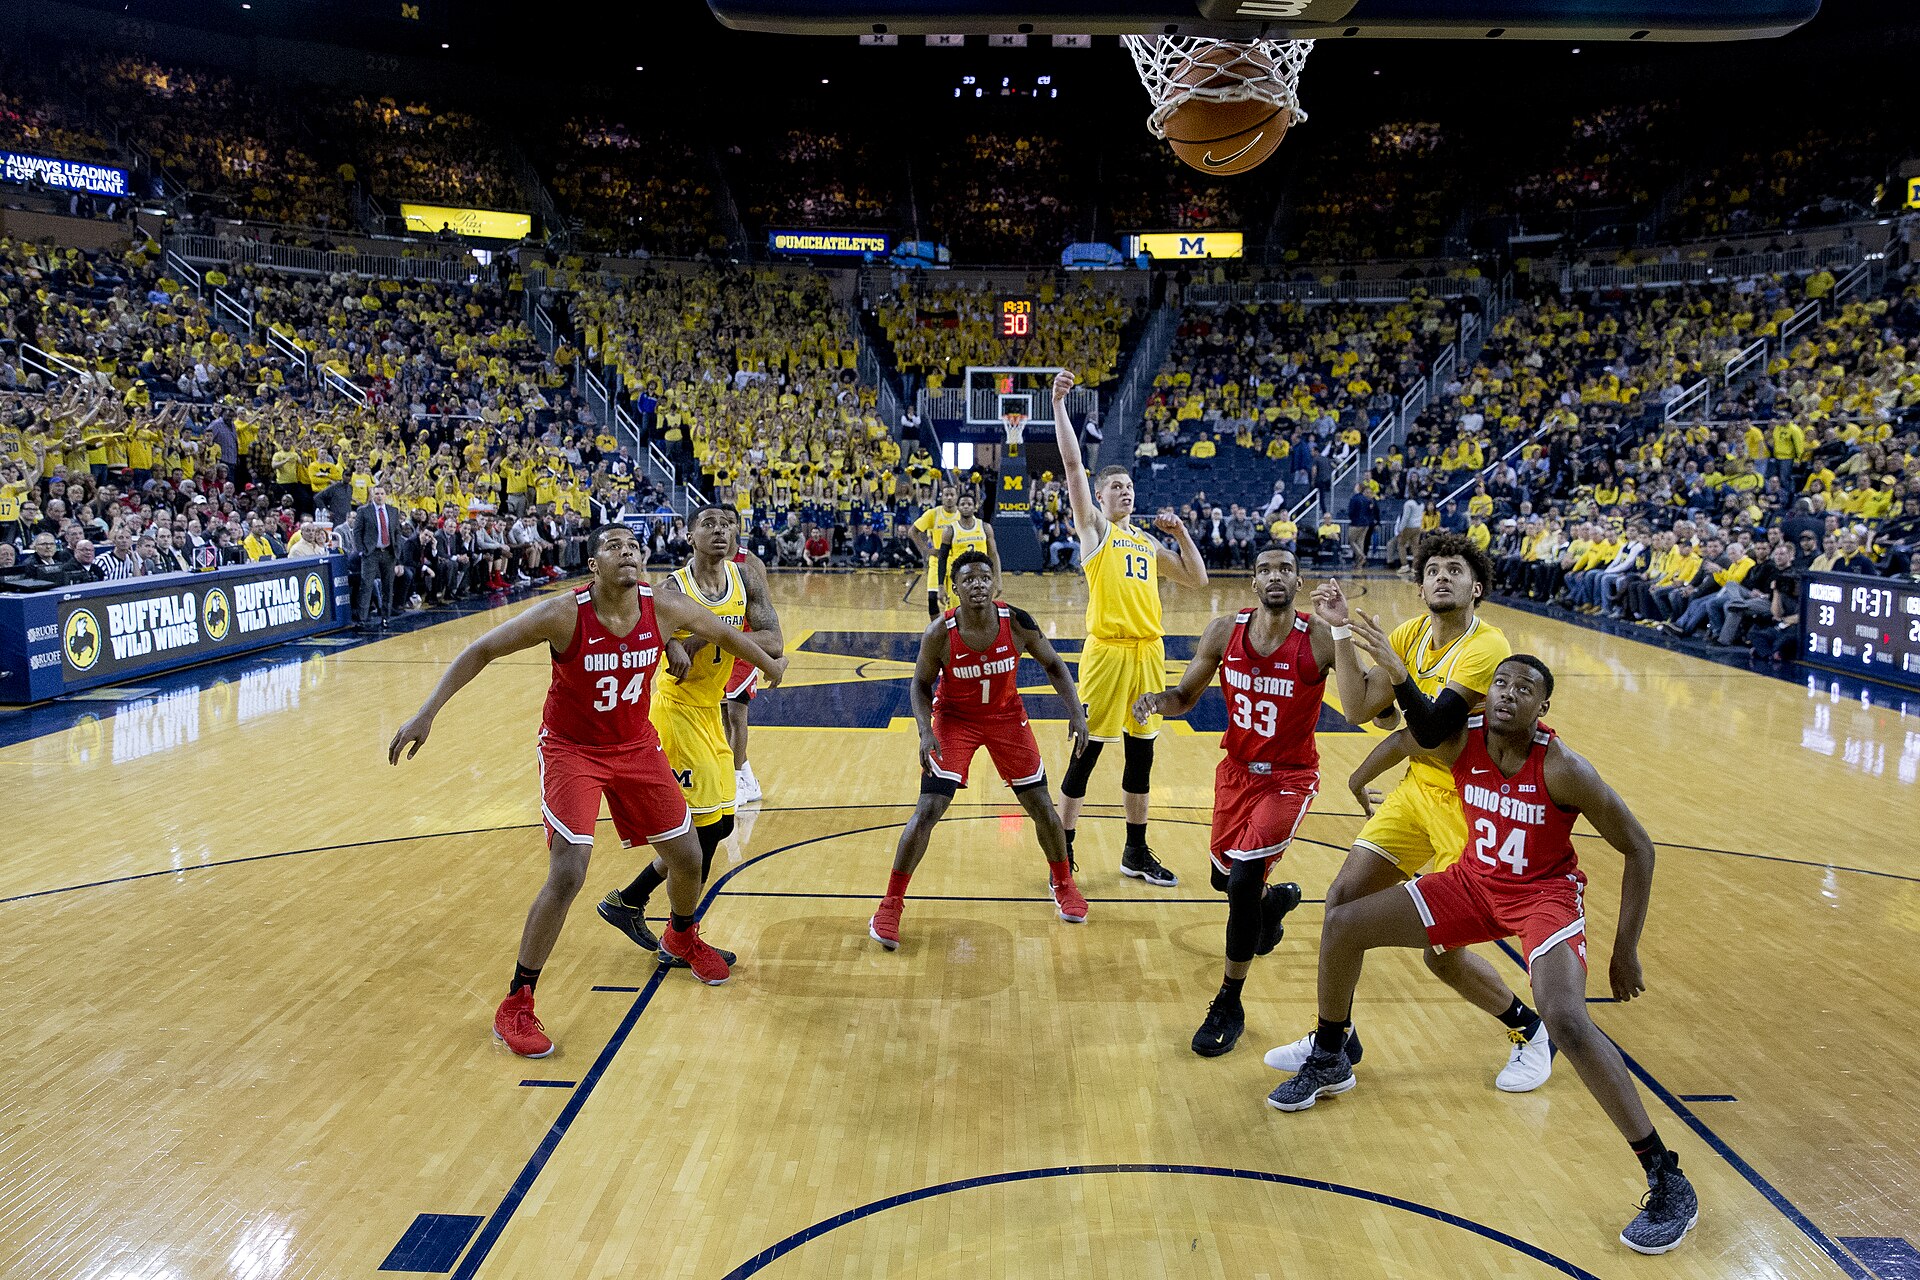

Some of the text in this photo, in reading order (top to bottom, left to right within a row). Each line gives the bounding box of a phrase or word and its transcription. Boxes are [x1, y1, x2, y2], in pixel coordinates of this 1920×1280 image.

[7, 154, 61, 174] ALWAYS
[65, 163, 124, 183] LEADING.
[7, 166, 67, 186] FORVER
[69, 174, 124, 194] VALIANT.
[1180, 238, 1204, 255] M
[1004, 301, 1030, 313] 19:37
[1004, 314, 1028, 335] 30
[1003, 476, 1023, 490] M
[1125, 554, 1147, 580] 13
[233, 576, 300, 613] BUFFALO
[1851, 587, 1892, 617] 19:37
[106, 592, 197, 636] BUFFALO
[236, 602, 301, 633] WILD WINGS
[1819, 605, 1835, 626] 33
[35, 624, 58, 637] RUOFF
[110, 622, 199, 660] WILD WINGS
[1809, 632, 1818, 652] 3
[1909, 620, 1920, 642] 2
[38, 651, 61, 665] RUOFF
[584, 646, 659, 672] OHIO STATE
[1832, 637, 1842, 657] 0
[1862, 643, 1873, 664] 2
[952, 656, 1015, 679] OHIO STATE
[593, 672, 645, 712] 34
[980, 679, 990, 704] 1
[1225, 666, 1294, 698] OHIO STATE
[1233, 693, 1278, 738] 33
[1464, 784, 1546, 825] OHIO STATE
[1475, 818, 1529, 875] 24
